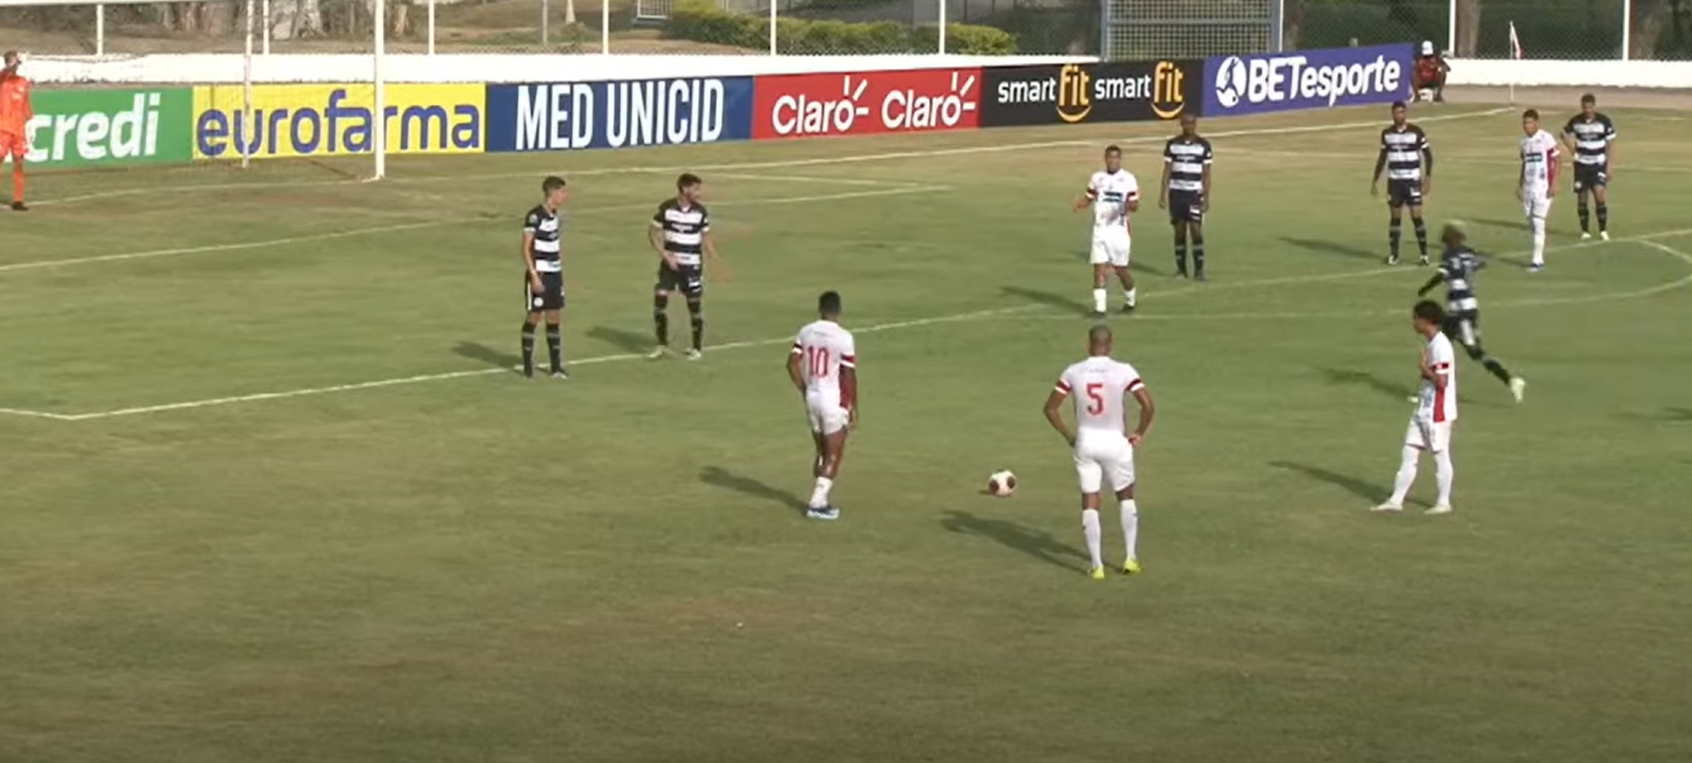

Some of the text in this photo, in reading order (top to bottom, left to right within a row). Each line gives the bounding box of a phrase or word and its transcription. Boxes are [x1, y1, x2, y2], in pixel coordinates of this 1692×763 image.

[1247, 54, 1401, 107] BETesporte
[4, 93, 161, 163] credi
[515, 78, 724, 151] MED UNICID
[772, 89, 962, 134] Claro Claro
[807, 344, 829, 378] 10
[1086, 382, 1104, 416] 5
